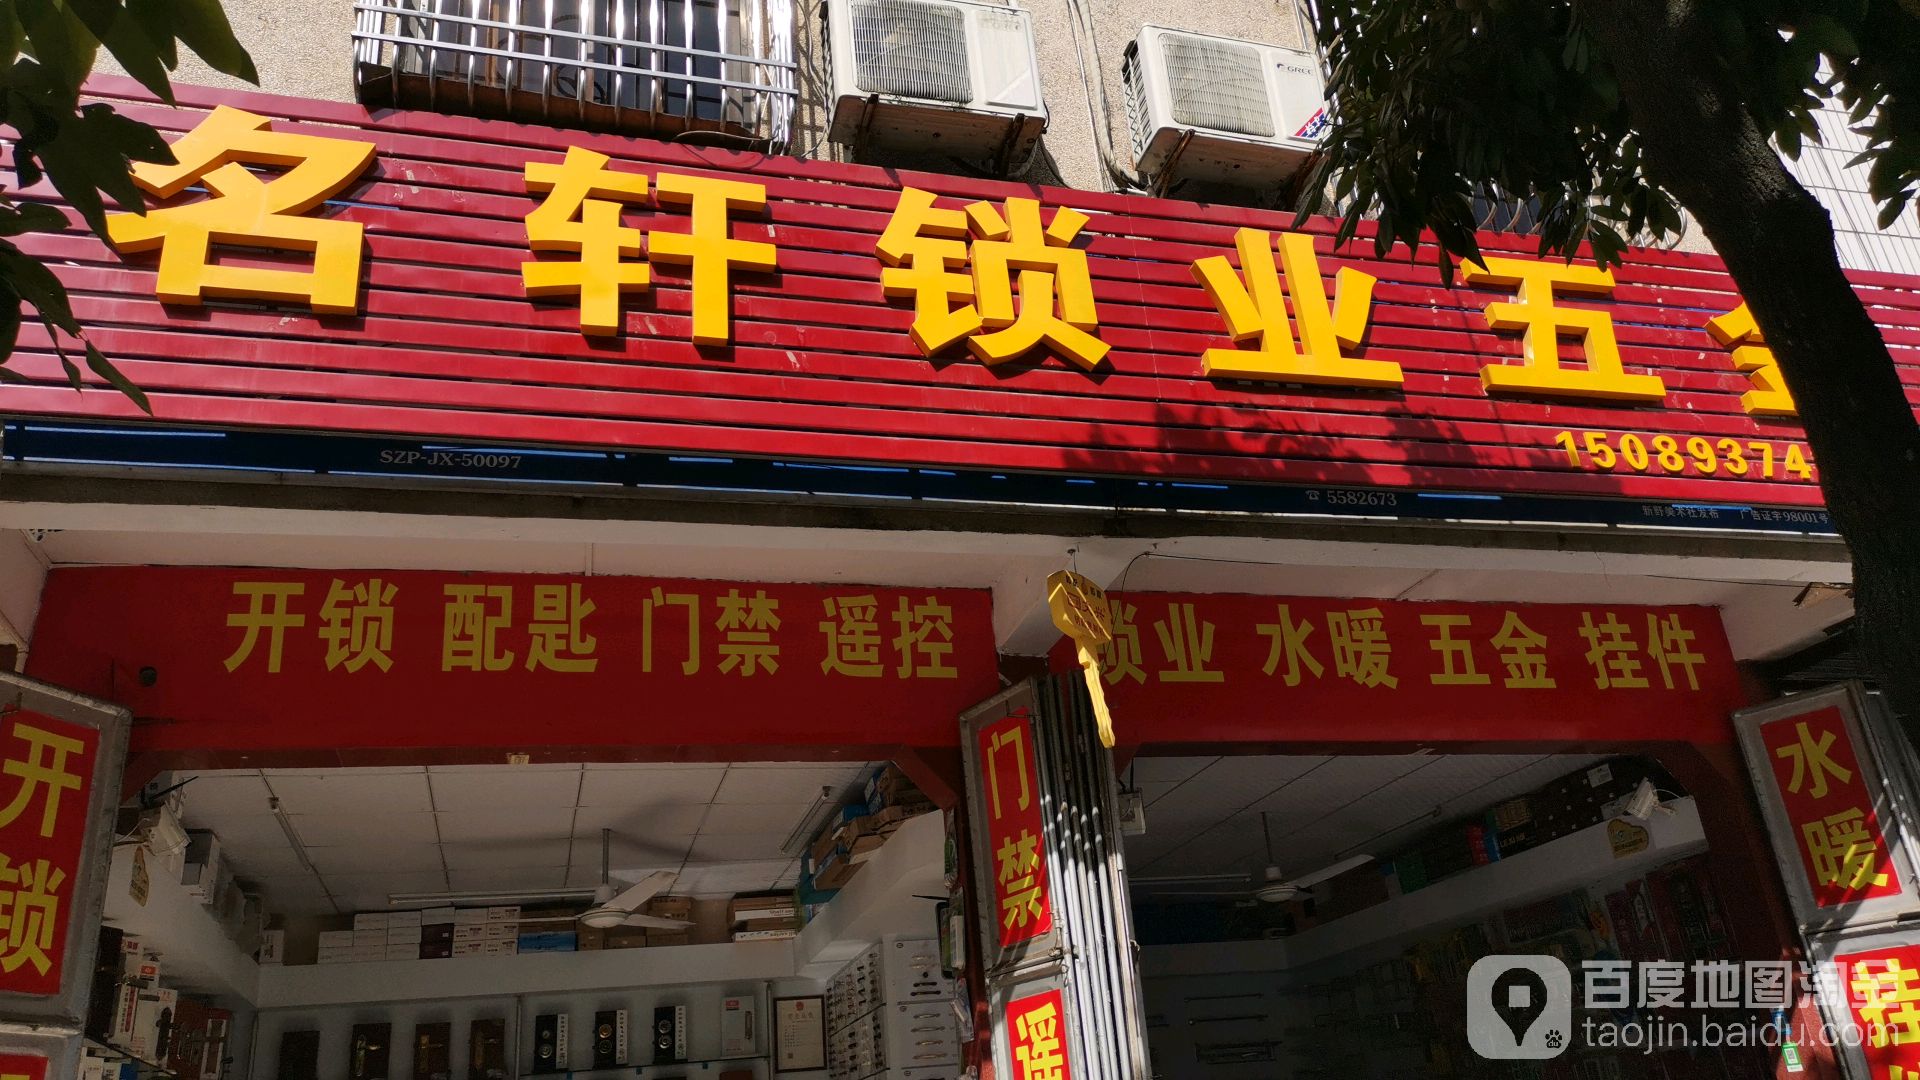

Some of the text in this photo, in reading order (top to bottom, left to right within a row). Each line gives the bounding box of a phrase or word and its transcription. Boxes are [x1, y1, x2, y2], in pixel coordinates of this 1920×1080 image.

[379, 448, 522, 470] SZP-JX-50097
[1326, 489, 1398, 507] 5582673
[224, 578, 399, 674] 开锁
[442, 584, 599, 674] 配匙
[642, 587, 781, 677] 门禁
[819, 595, 960, 681] 遥控
[1256, 604, 1399, 690] 水暖
[1420, 611, 1557, 690] 五金
[1579, 611, 1706, 690] 挂件
[0, 721, 85, 978] 开锁
[987, 726, 1043, 930] 门禁
[1776, 722, 1889, 892] 水暖
